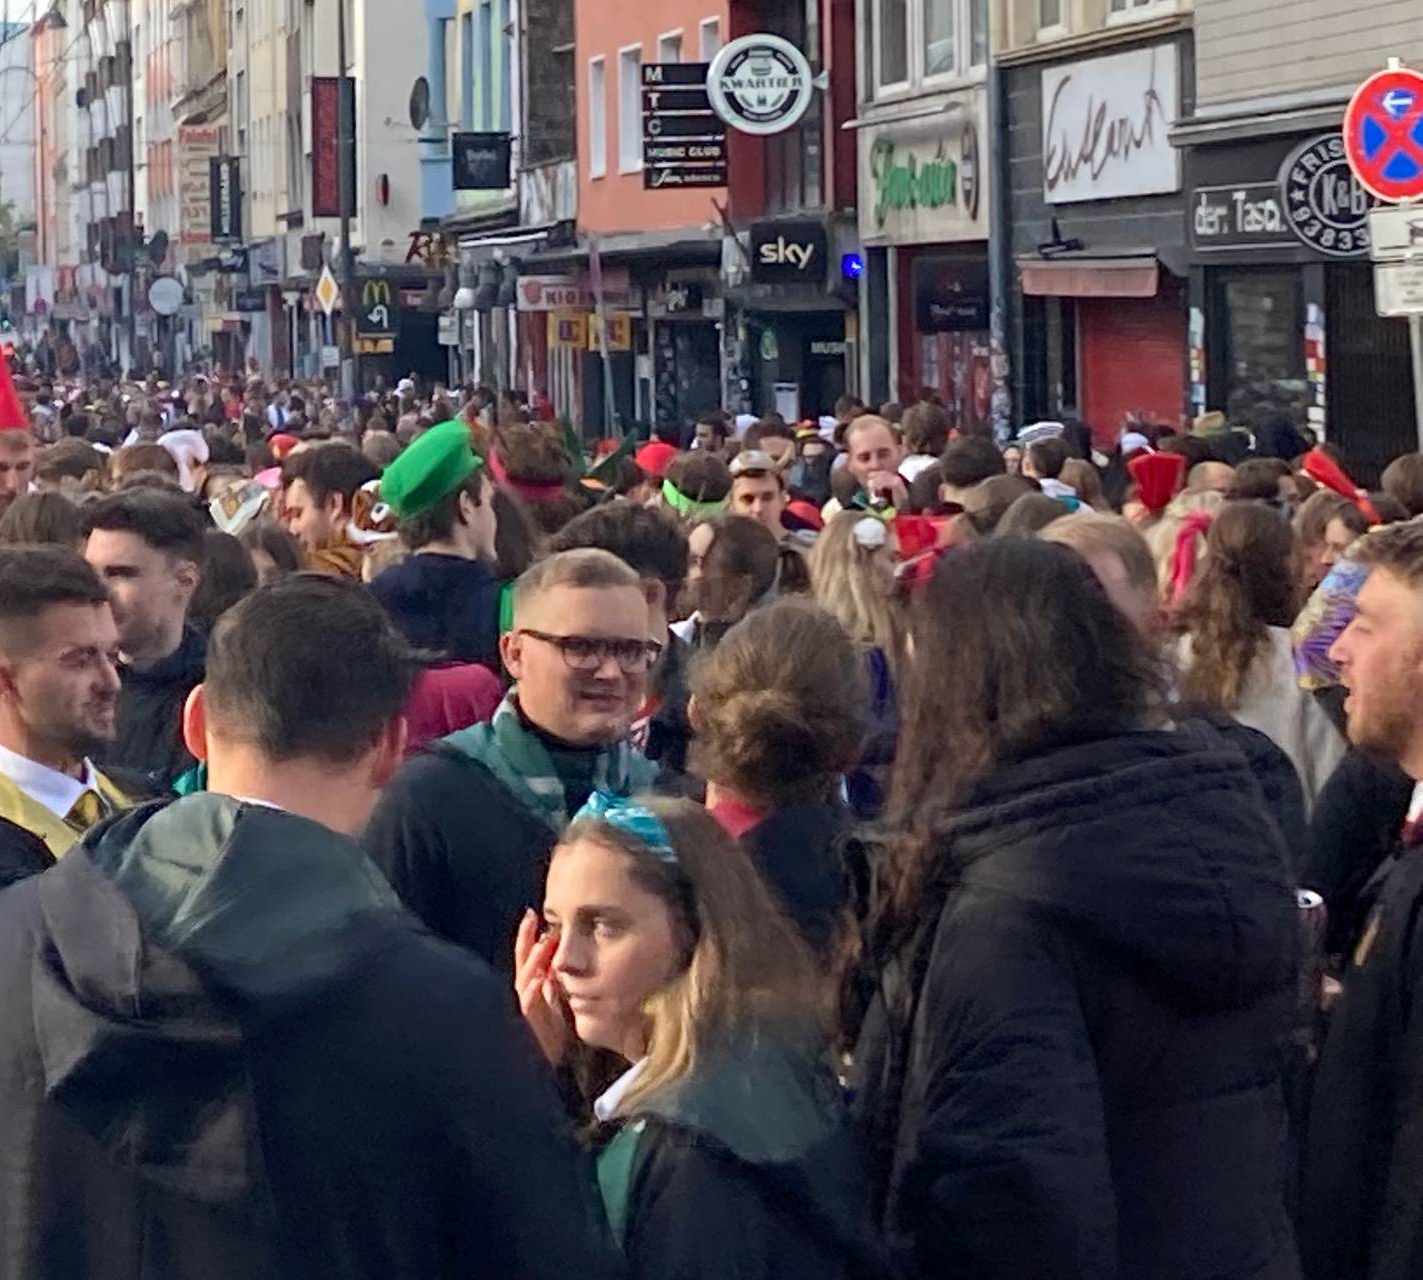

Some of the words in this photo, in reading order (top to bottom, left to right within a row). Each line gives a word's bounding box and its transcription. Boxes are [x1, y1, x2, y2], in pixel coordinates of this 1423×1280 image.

[645, 66, 663, 82] M
[720, 77, 802, 89] KWARTIER
[648, 92, 660, 108] T
[648, 118, 661, 135] C
[647, 147, 685, 158] MUSIC
[688, 146, 721, 157] CLUB
[1292, 139, 1345, 184] FRIS
[1293, 206, 1370, 249] 93833
[760, 235, 814, 270] sky
